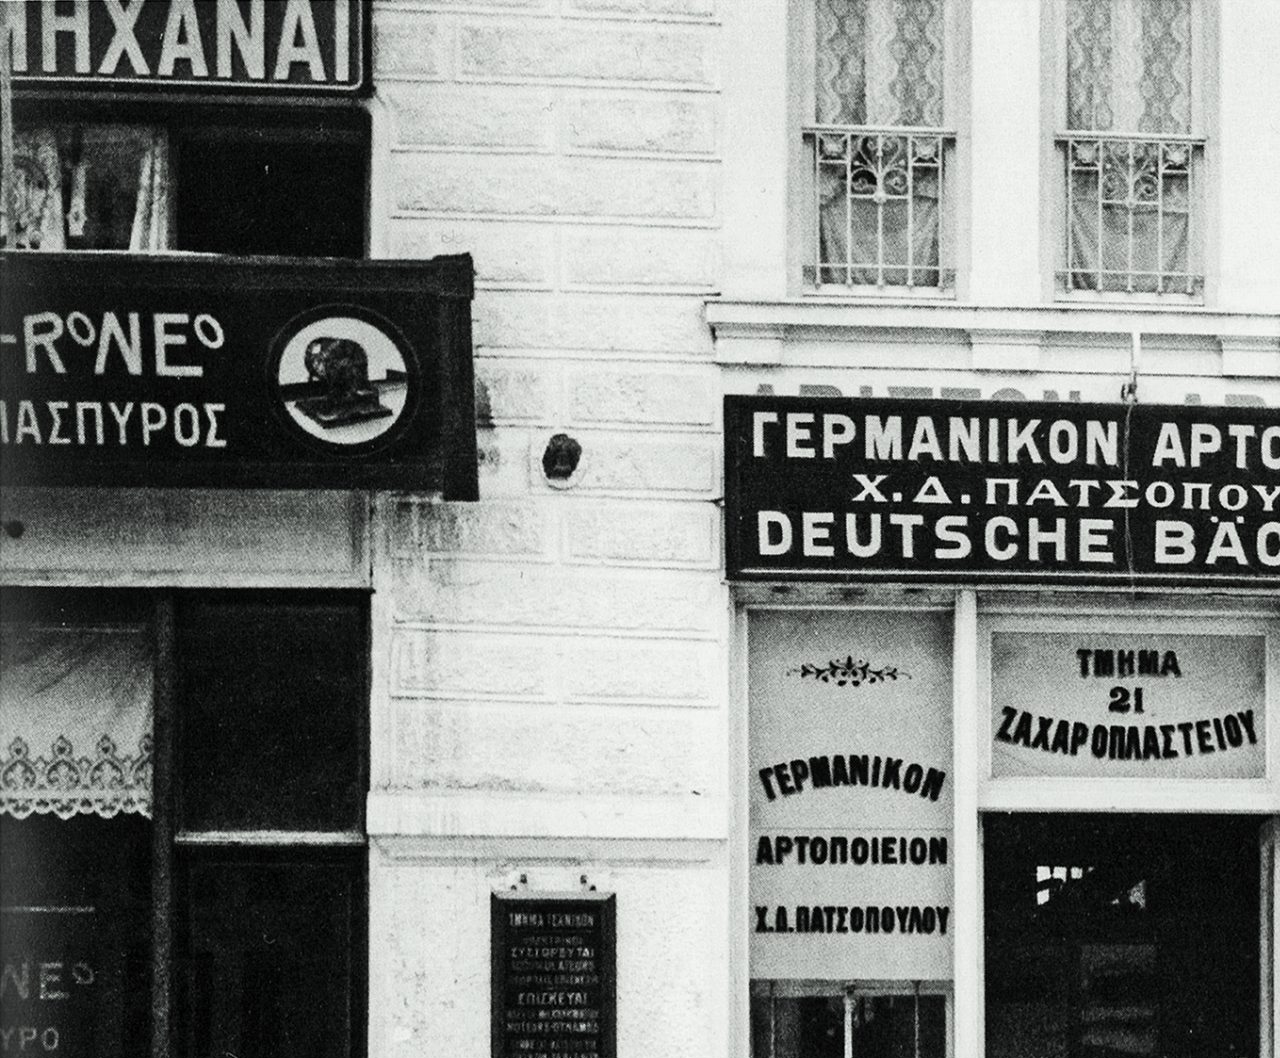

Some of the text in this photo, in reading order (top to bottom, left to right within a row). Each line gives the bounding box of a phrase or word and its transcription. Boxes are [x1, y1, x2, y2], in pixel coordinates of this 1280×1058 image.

[752, 411, 1119, 467] ΓΕΡΜΑΝΙΚΟΝ
[757, 510, 1115, 564] DEUTSCHE
[1076, 649, 1182, 679] ΤΜΗΜΑ
[994, 706, 1257, 760] ΖΑΧΑΡΟΠΛΑΣΤΕΙΟΥ
[759, 754, 946, 802] ΓΕΡΜΑΝΙΚΟΝ
[756, 836, 948, 865] ΑΡΤΟΠΟΙΕΙΟΝ
